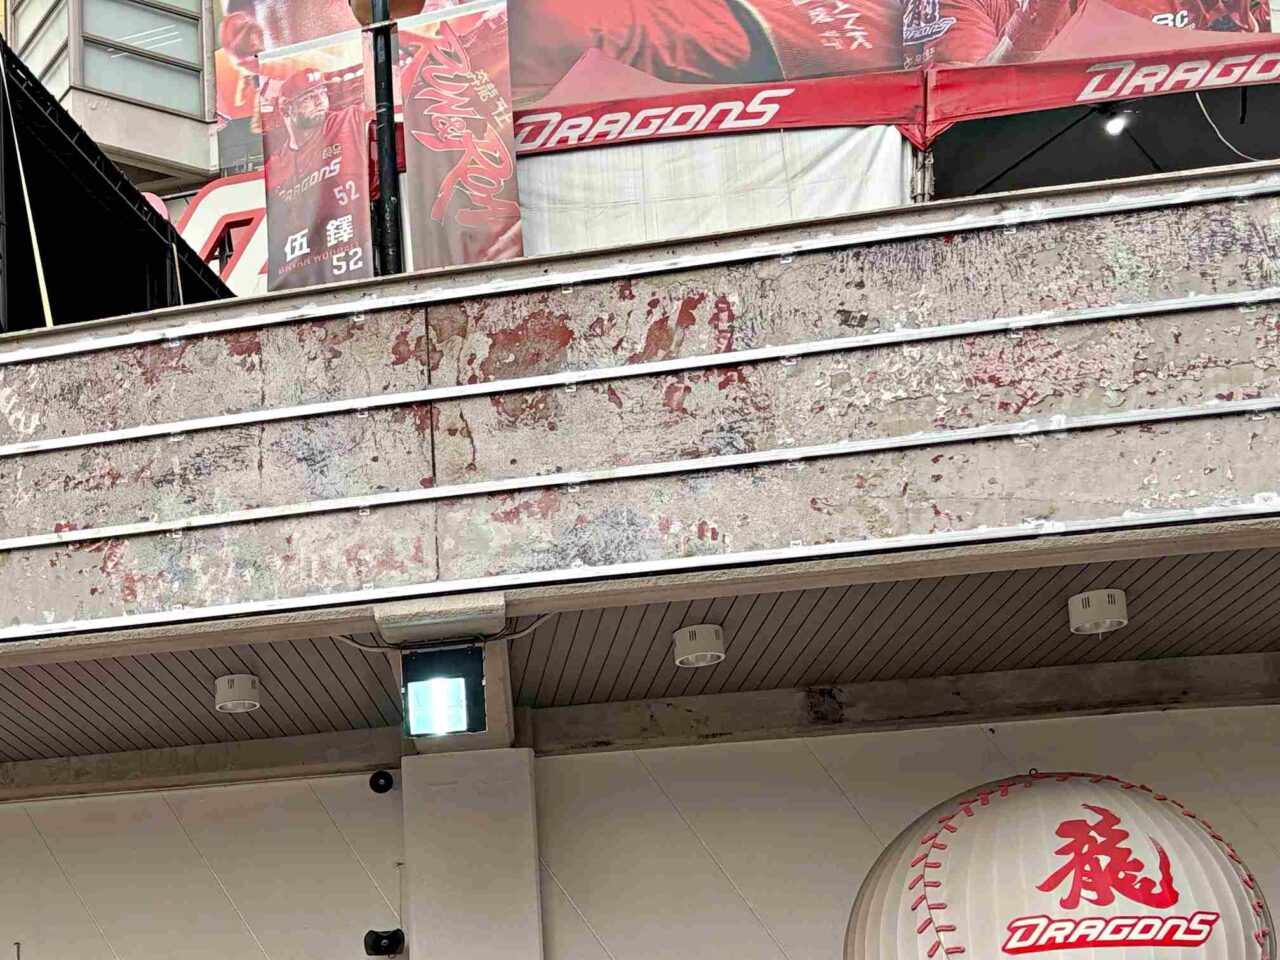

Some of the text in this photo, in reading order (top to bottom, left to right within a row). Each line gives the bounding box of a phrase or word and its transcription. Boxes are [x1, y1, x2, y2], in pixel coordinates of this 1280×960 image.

[515, 89, 795, 146] DRAGONS
[333, 180, 361, 206] 52
[332, 247, 364, 275] 52
[1035, 803, 1180, 909] 龍
[1002, 911, 1220, 955] DRAGONS
